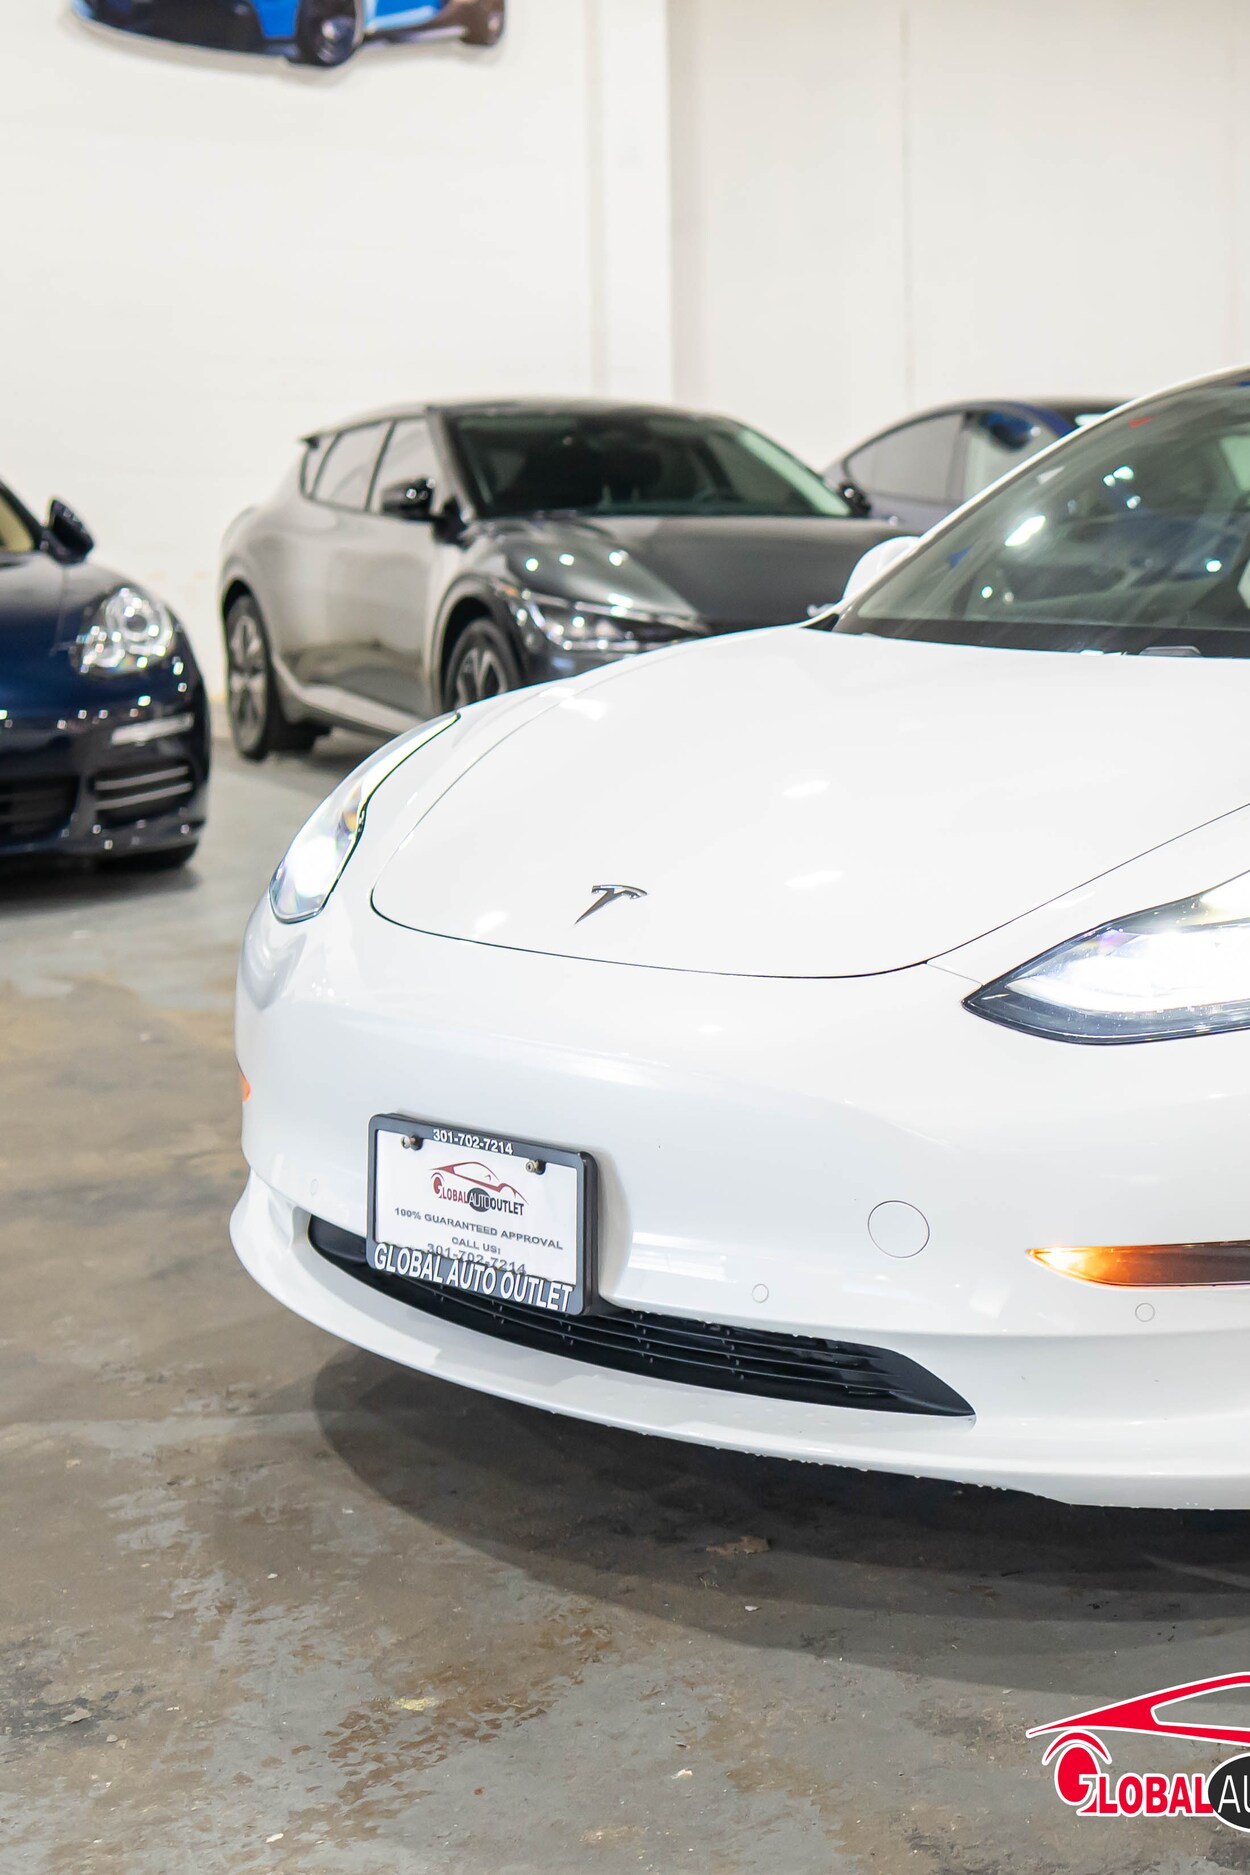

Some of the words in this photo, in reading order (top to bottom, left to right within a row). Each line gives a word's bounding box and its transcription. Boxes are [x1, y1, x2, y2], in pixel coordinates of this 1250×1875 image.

[433, 1128, 514, 1155] 301-702-7214
[433, 1176, 469, 1204] GLOBAL
[468, 1192, 491, 1209] AUTO
[489, 1197, 525, 1216] OUTLET
[395, 1207, 422, 1221] 100%
[424, 1213, 498, 1236] GUARANTEED
[500, 1230, 563, 1251] APPROVAL
[451, 1236, 480, 1251] CALL
[374, 1243, 443, 1284] GLOBAL
[446, 1259, 497, 1296] AUTO
[500, 1271, 574, 1312] OUTLET
